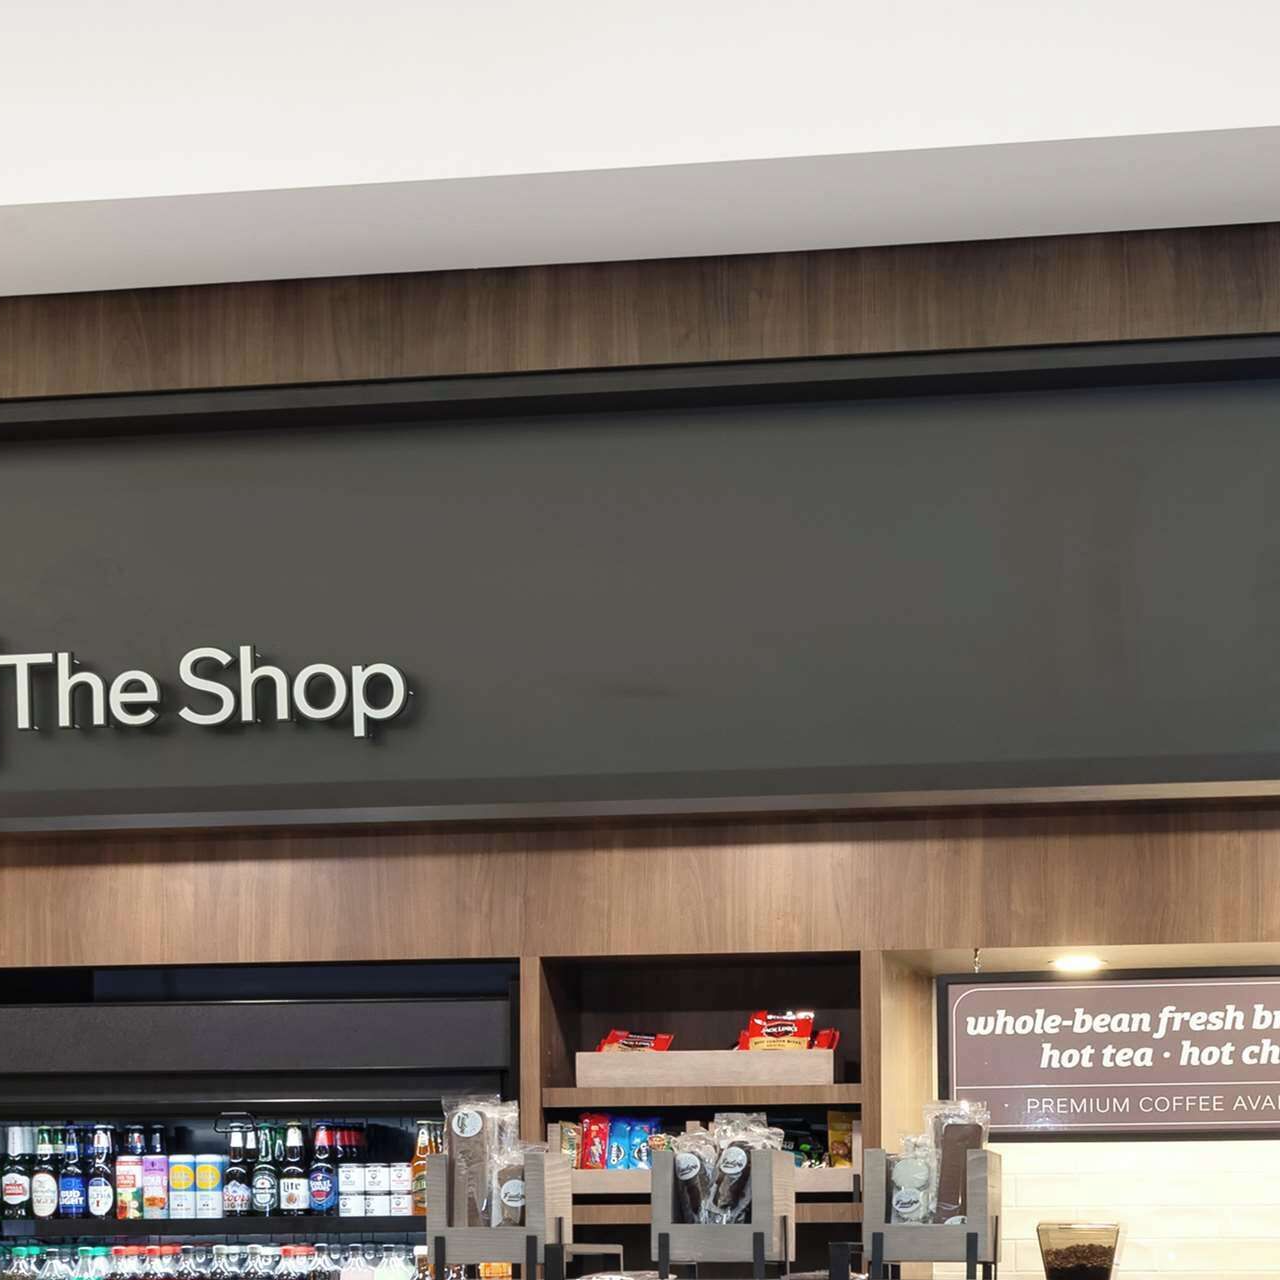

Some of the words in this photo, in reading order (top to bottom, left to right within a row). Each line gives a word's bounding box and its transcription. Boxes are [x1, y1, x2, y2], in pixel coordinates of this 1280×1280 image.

[177, 645, 410, 738] Shop
[965, 1009, 1158, 1036] whole-bean
[1153, 1004, 1242, 1039] fresh
[1040, 1042, 1094, 1069] hot
[1101, 1044, 1153, 1068] tea
[1179, 1040, 1235, 1067] hot
[1026, 1096, 1131, 1114] PREMIUM
[1138, 1095, 1225, 1113] COFFEE
